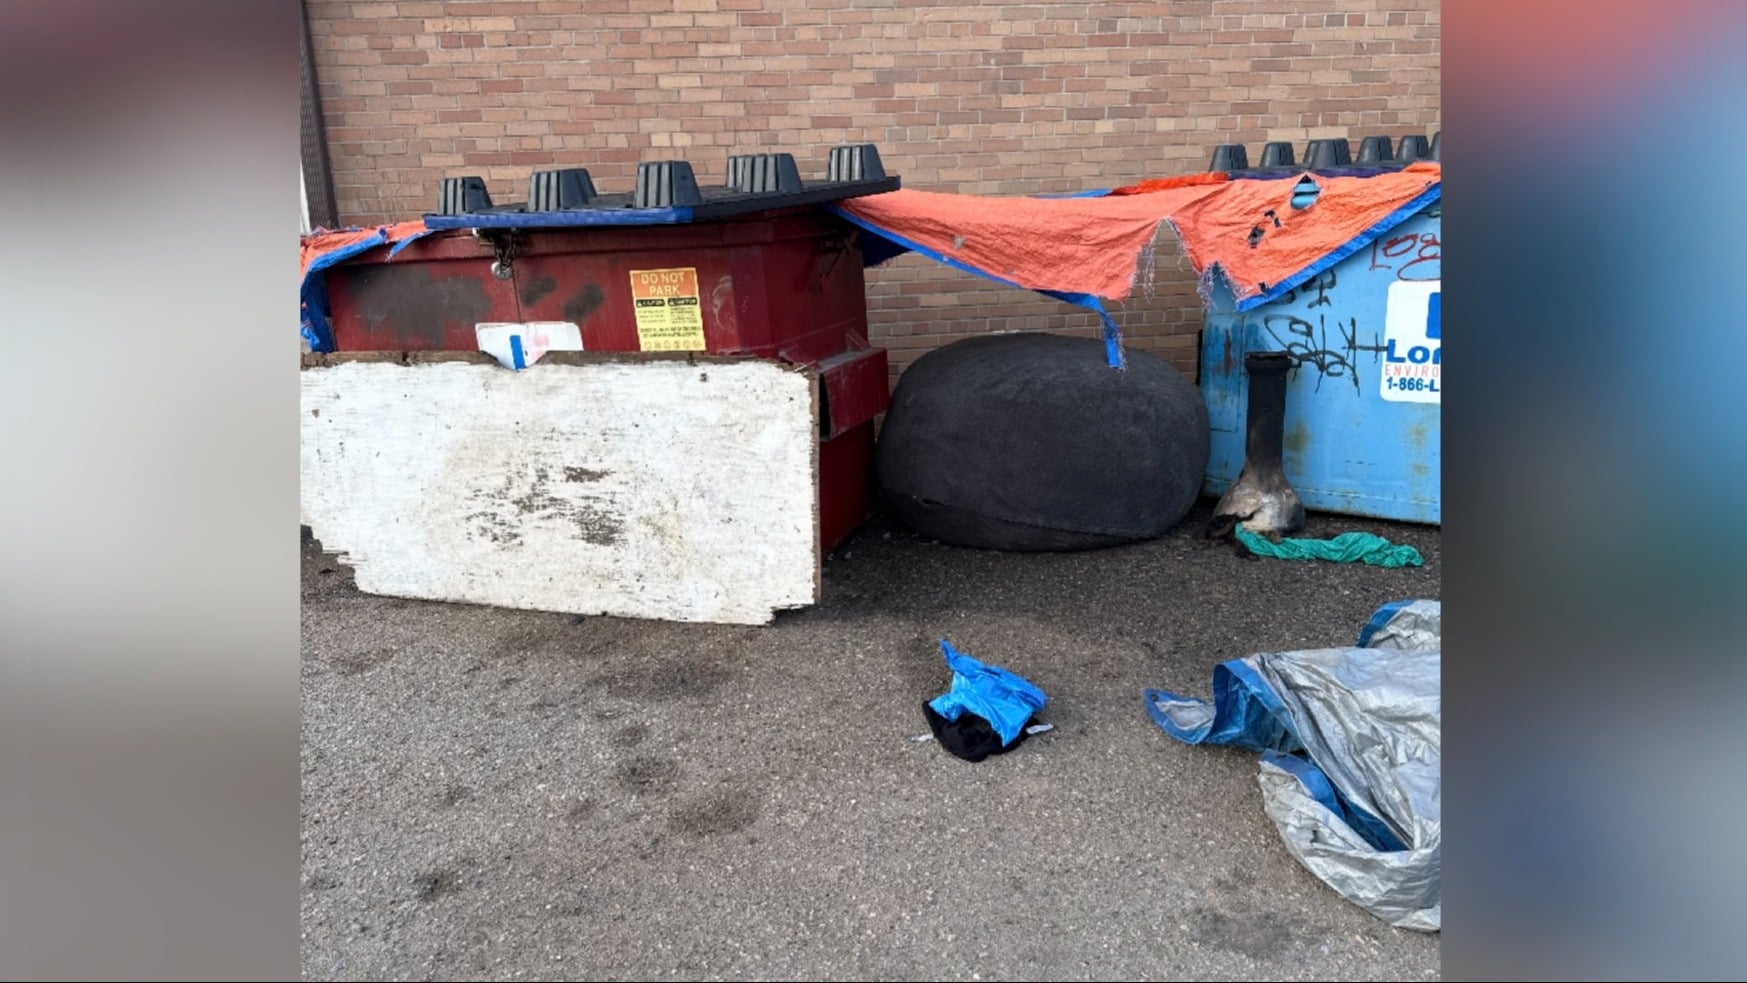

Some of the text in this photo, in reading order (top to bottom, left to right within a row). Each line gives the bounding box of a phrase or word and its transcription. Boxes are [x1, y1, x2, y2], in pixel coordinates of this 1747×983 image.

[641, 272, 685, 284] DO NOT
[649, 285, 681, 296] PARK
[1385, 364, 1439, 377] ENVIRO
[1386, 376, 1440, 392] 1-866-L
